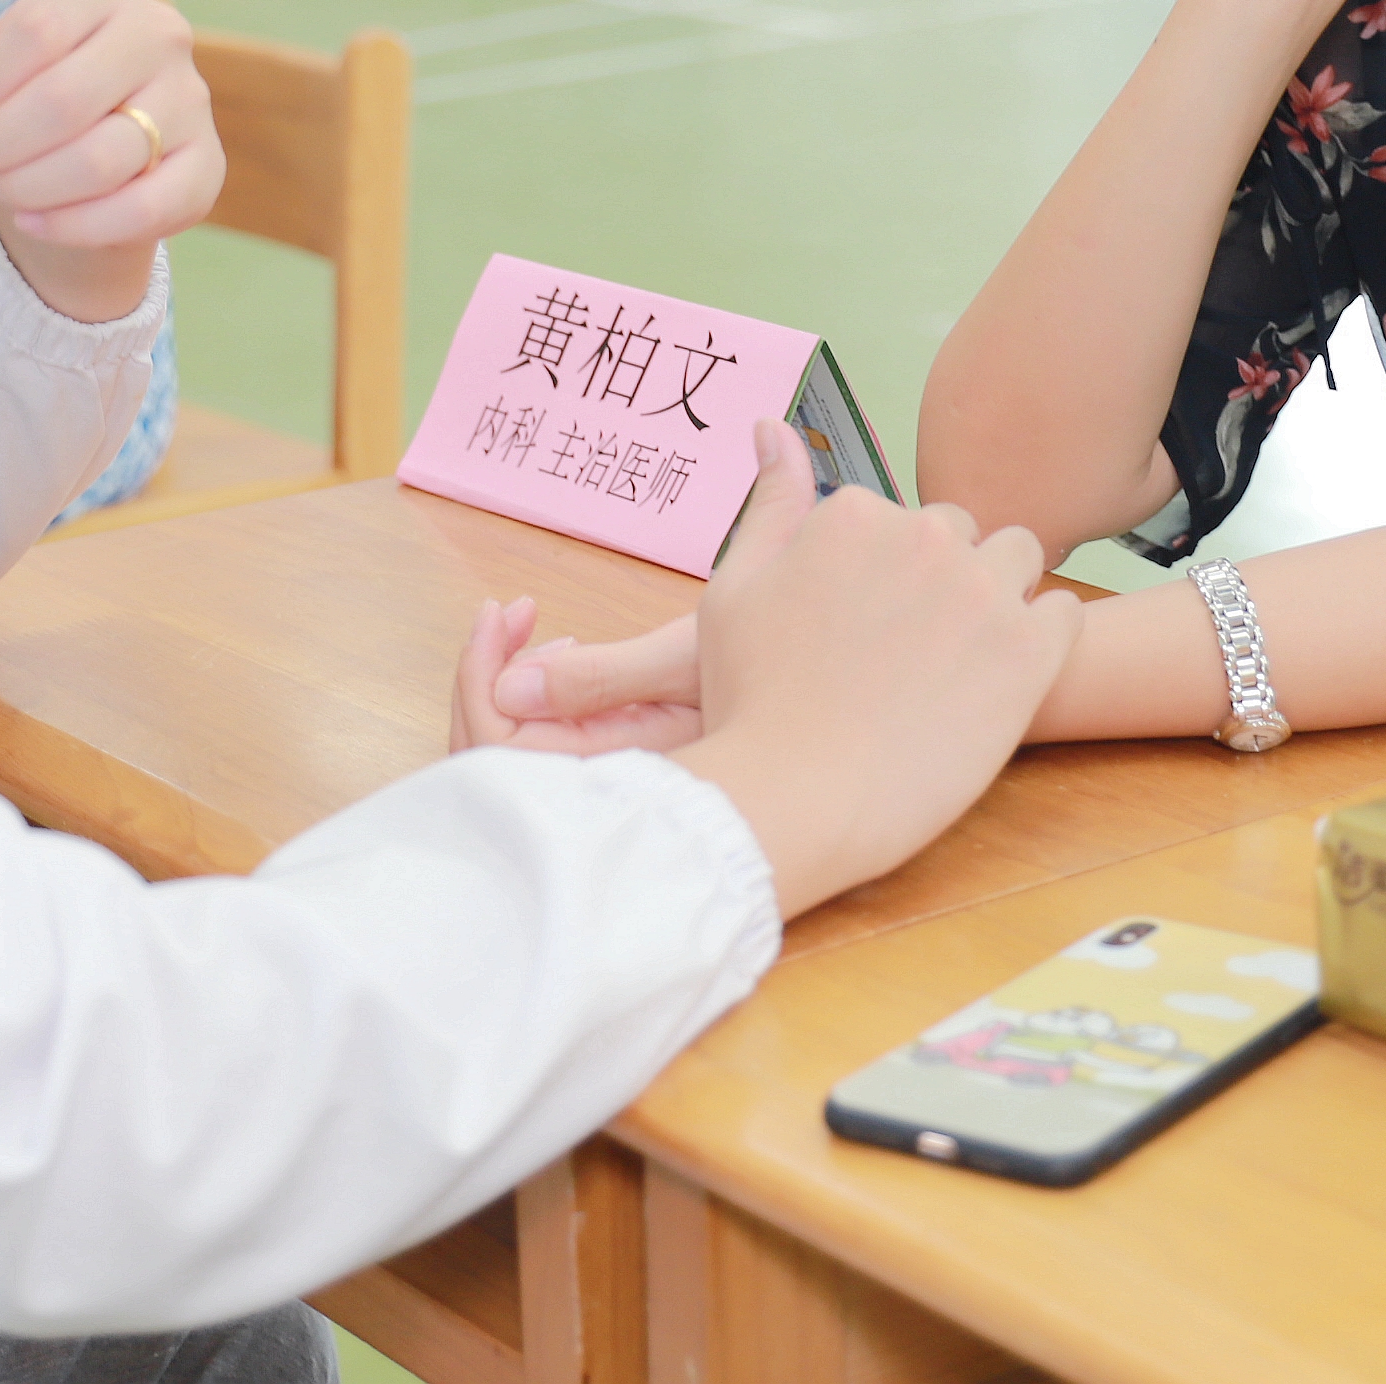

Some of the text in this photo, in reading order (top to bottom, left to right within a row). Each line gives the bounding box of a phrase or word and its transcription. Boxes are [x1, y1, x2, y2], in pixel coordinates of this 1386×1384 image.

[500, 286, 738, 432] 黄柏文
[466, 394, 698, 514] 内科 主治医师
